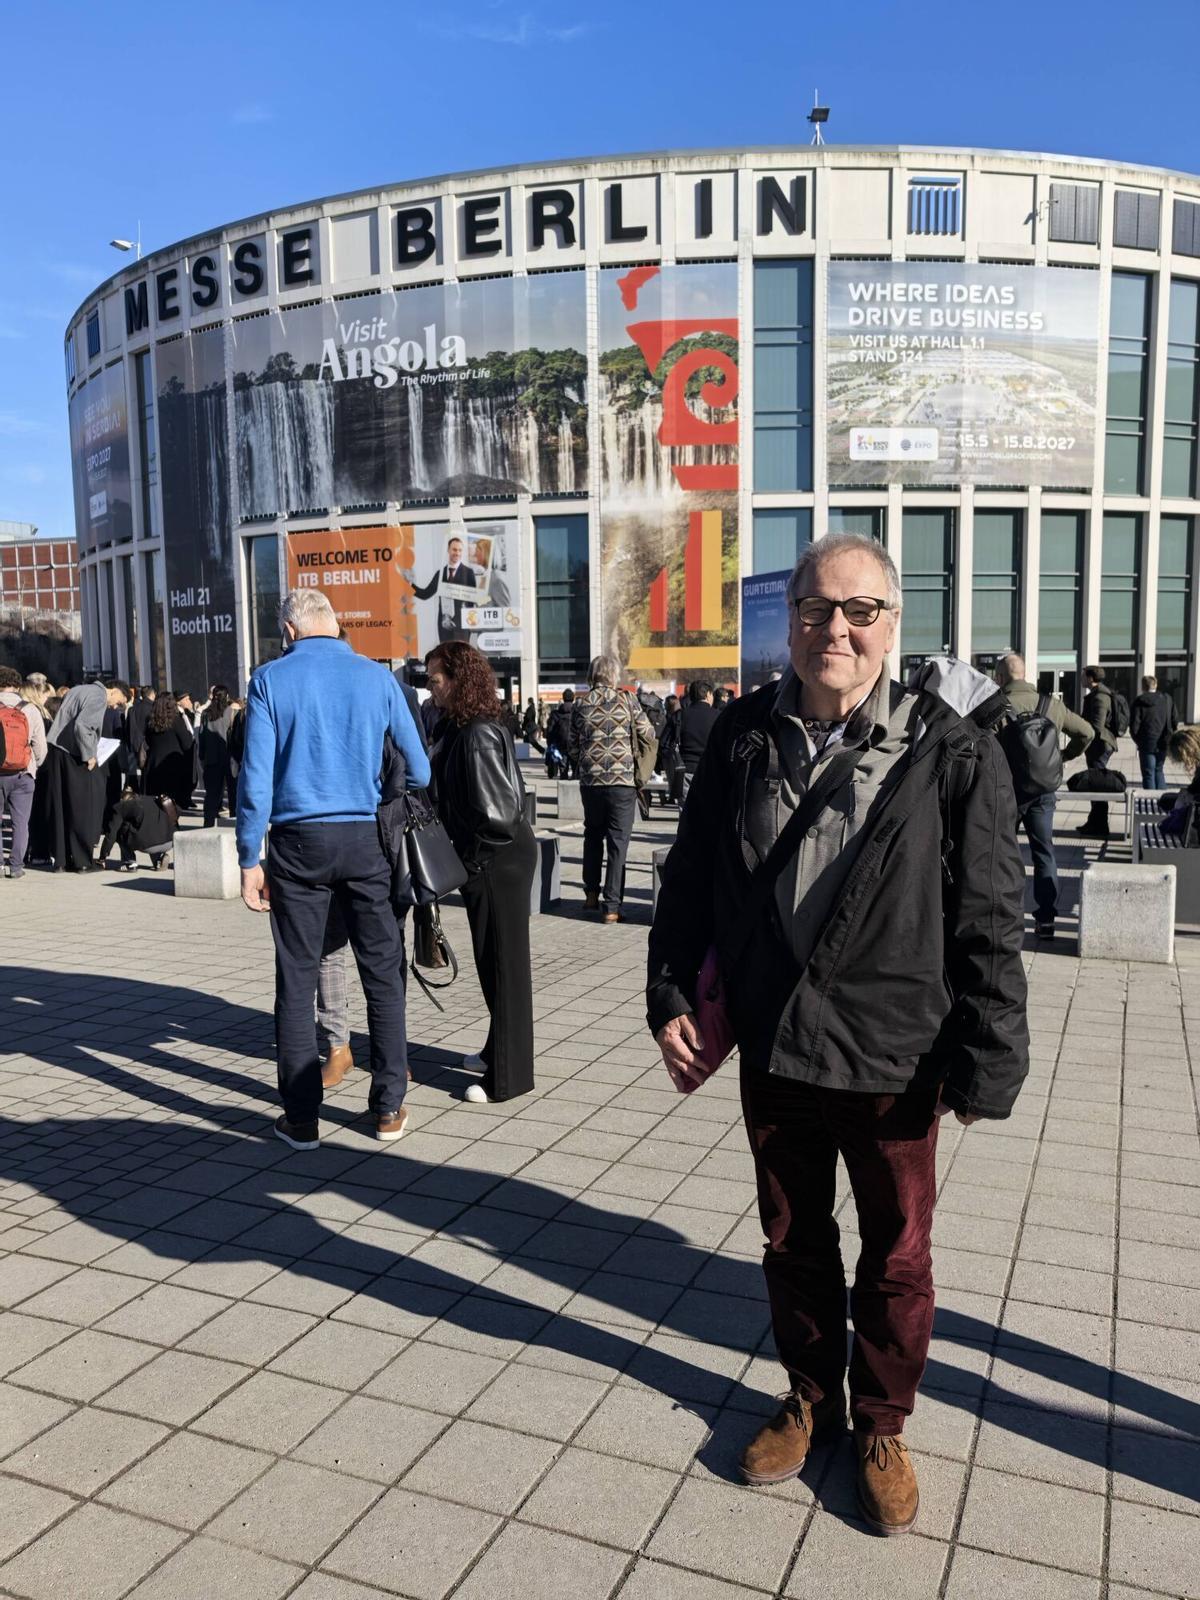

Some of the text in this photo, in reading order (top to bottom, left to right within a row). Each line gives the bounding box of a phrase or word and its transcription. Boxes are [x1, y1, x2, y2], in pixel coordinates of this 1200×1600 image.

[124, 175, 807, 335] MESSE BERLIN
[848, 283, 1015, 305] WHERE IDEAS
[848, 307, 1043, 330] DRIVE BUSINESS
[339, 317, 388, 345] Visit
[850, 335, 887, 348] VISIT
[889, 335, 908, 348] US
[911, 336, 928, 348] AT
[931, 336, 969, 349] HALL
[317, 323, 468, 389] Angola
[849, 350, 923, 363] STAND 124
[401, 367, 491, 387] The Rhythm of Life
[960, 434, 988, 448] 15.5
[1003, 435, 1076, 450] 15.8.2027
[296, 548, 392, 567] WELCOME TO
[298, 569, 380, 587] ITB BERLIN!
[743, 579, 787, 597] GUATEMAL
[170, 587, 210, 608] Hall 21
[172, 613, 232, 636] Booth 112
[483, 610, 498, 619] ITB
